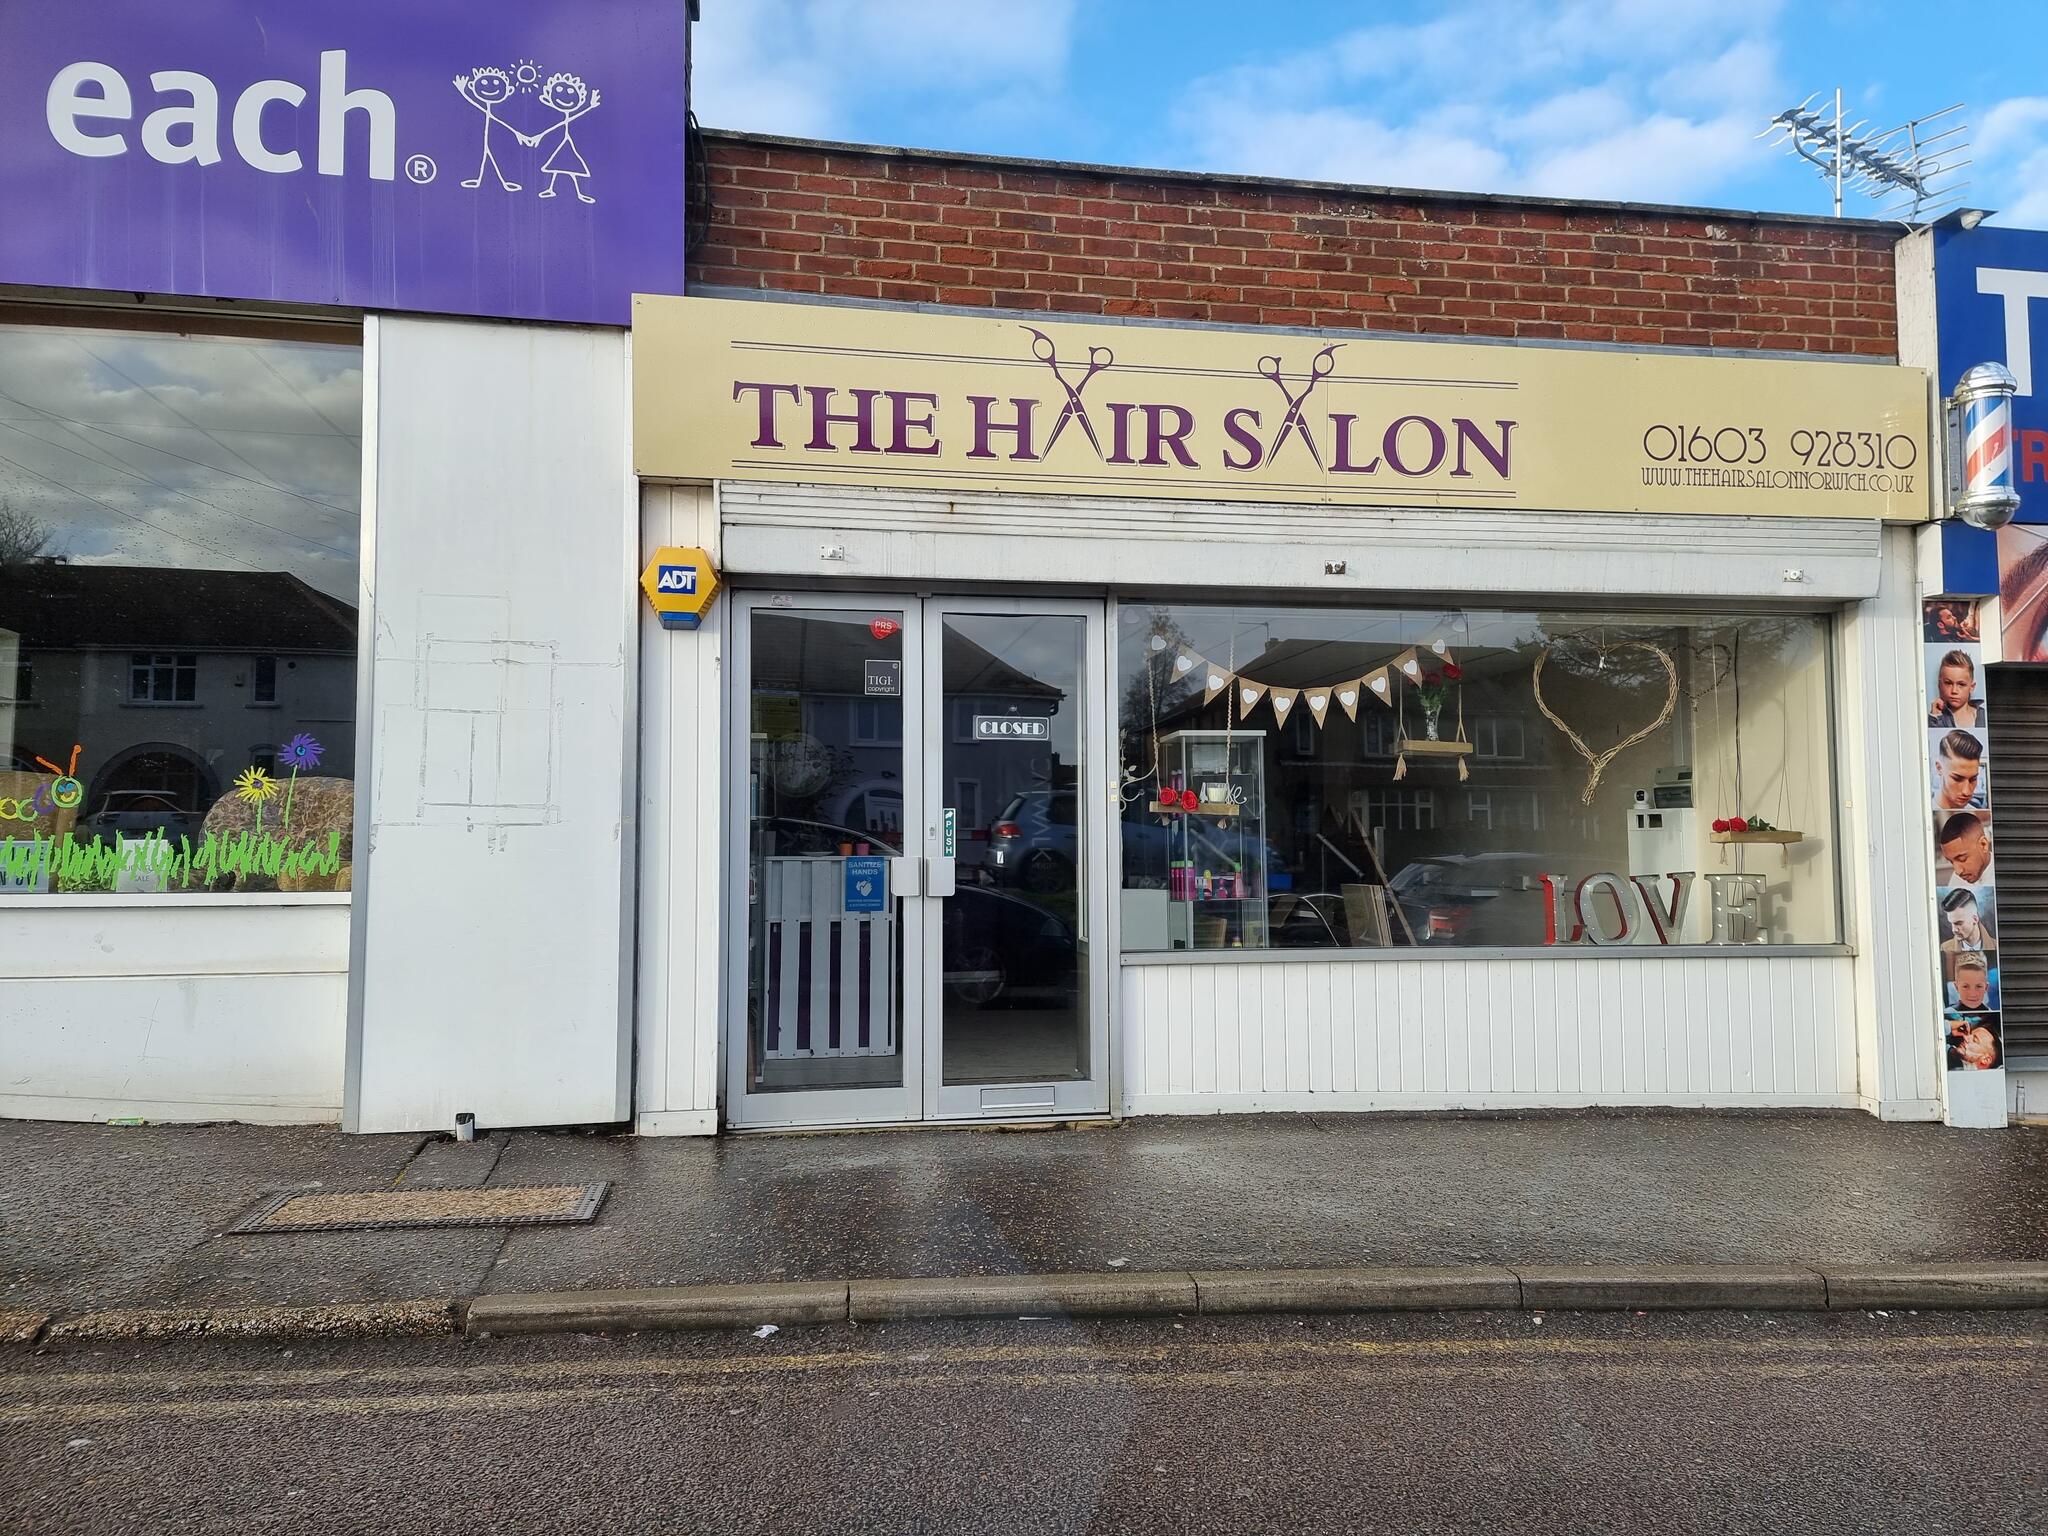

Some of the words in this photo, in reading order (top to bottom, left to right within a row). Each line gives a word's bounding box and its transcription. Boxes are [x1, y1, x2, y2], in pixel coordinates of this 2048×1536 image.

[46, 49, 397, 181] each
[732, 380, 943, 458] THE
[965, 375, 1200, 471] HAIR
[1222, 385, 1519, 481] SALON
[1643, 424, 1767, 464] 01603
[1790, 430, 1917, 470] 928310
[1641, 467, 1914, 493] WWW.THEHAIRSALONNORWICH.CO.UK
[658, 570, 696, 590] ADT
[874, 620, 893, 630] PRS
[979, 720, 1045, 735] CLOSED
[1539, 872, 1768, 946] LOVE
